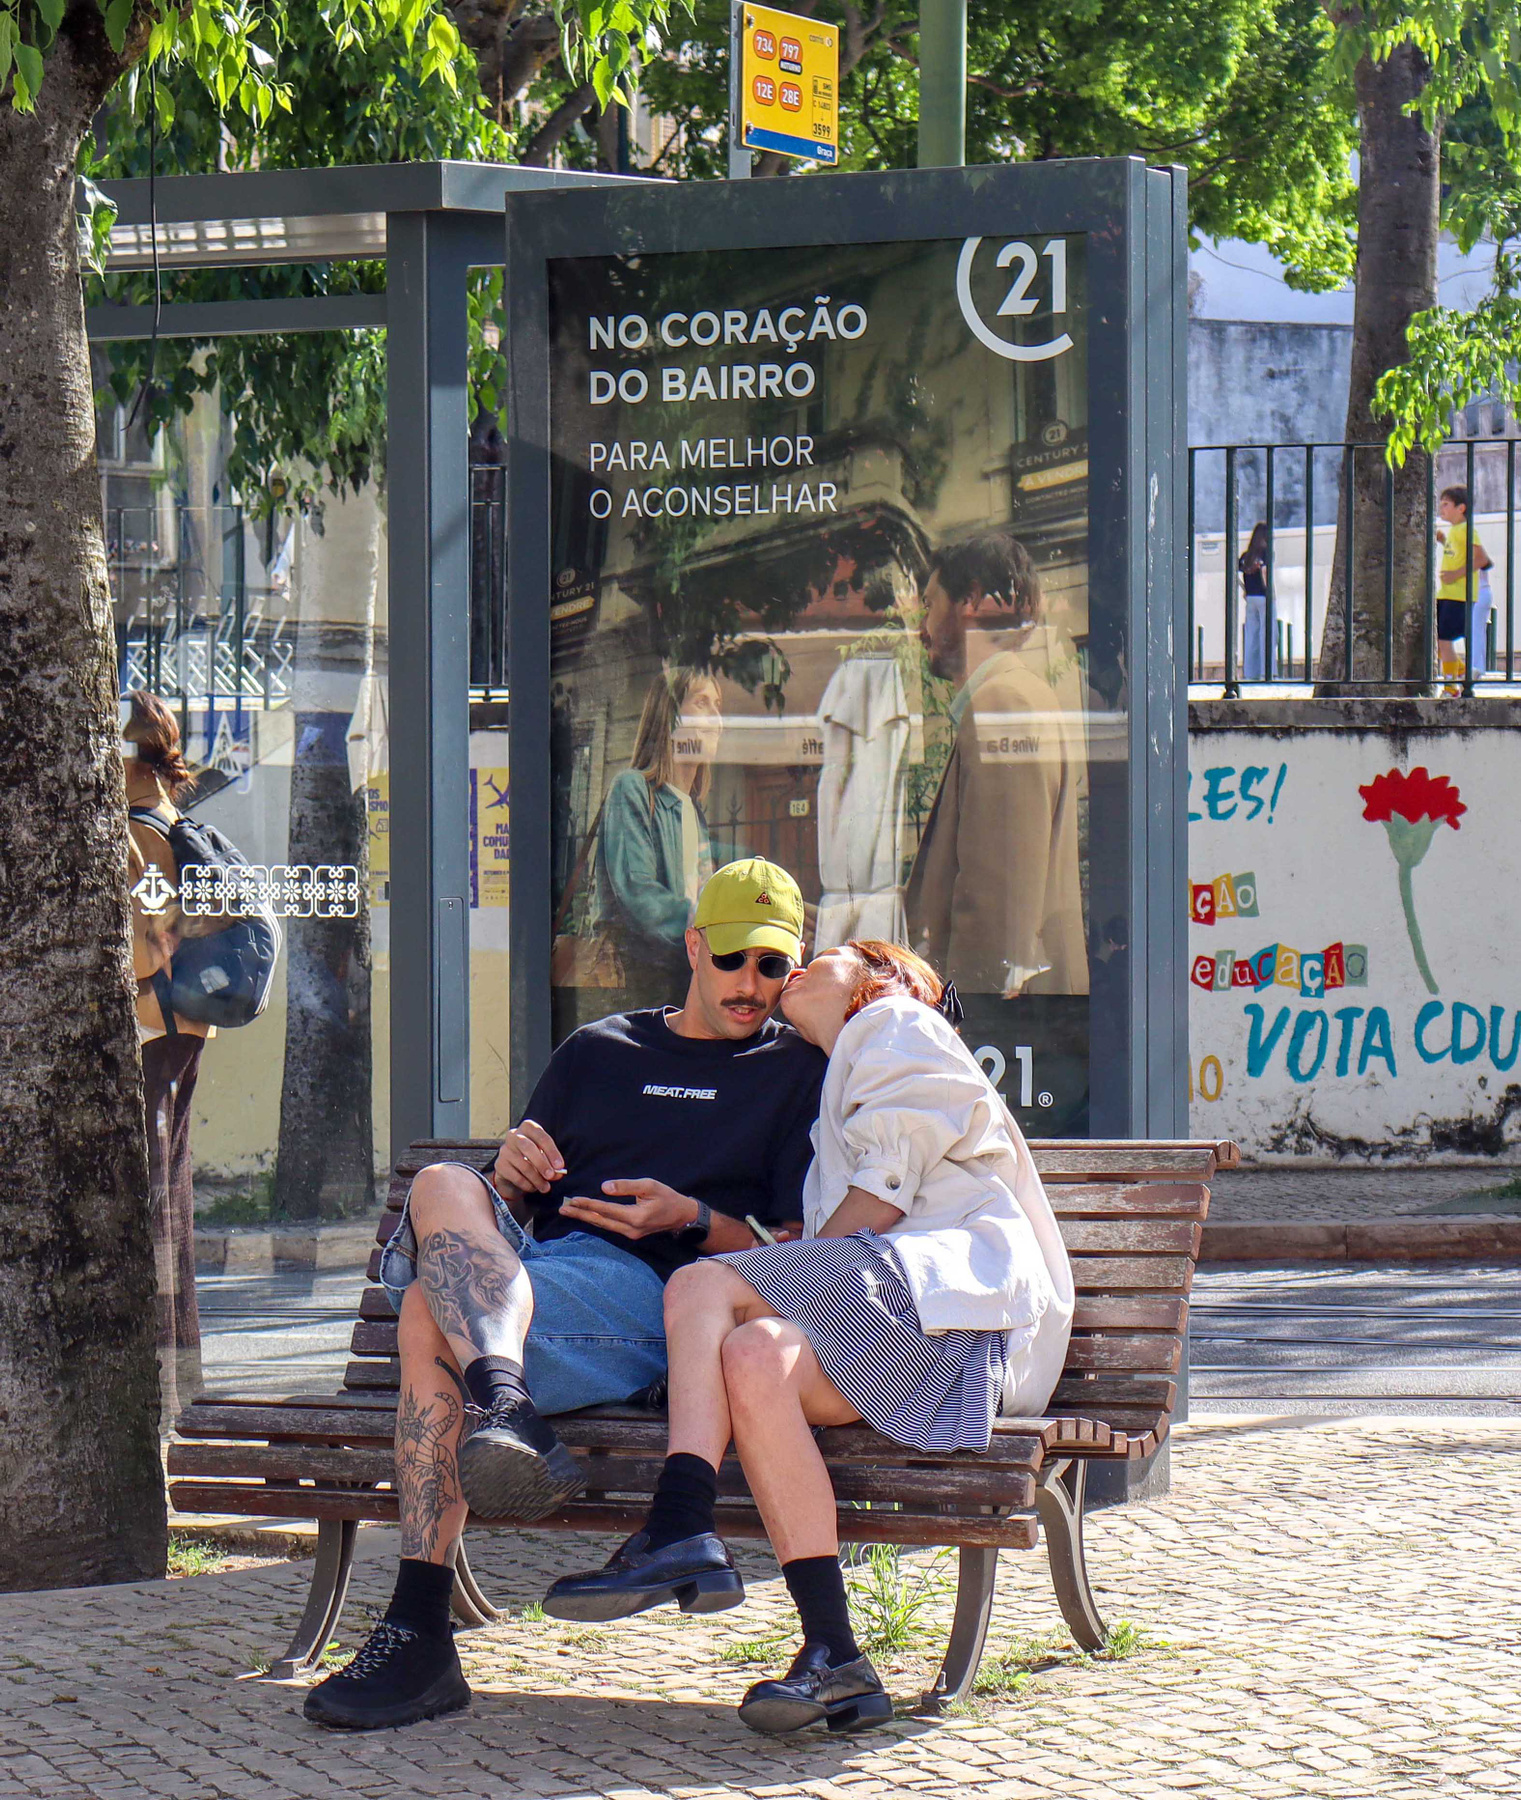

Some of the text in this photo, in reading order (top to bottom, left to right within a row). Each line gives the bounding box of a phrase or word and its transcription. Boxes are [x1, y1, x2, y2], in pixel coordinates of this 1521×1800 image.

[755, 36, 800, 60] 734 797
[756, 82, 774, 99] 12E
[781, 89, 800, 106] 28E
[813, 122, 831, 138] 3599
[817, 145, 834, 159] Graça
[588, 295, 869, 353] NO CORAÇÃO
[588, 362, 817, 405] DO BAIRRO
[588, 436, 815, 472] PARA MELHOR
[1017, 446, 1080, 468] CENTURY
[588, 482, 838, 519] O ACONSELHAR
[792, 802, 806, 814] 164
[1243, 1000, 1521, 1083] VOTA CDU
[642, 1084, 718, 1100] MEAT.FREE
